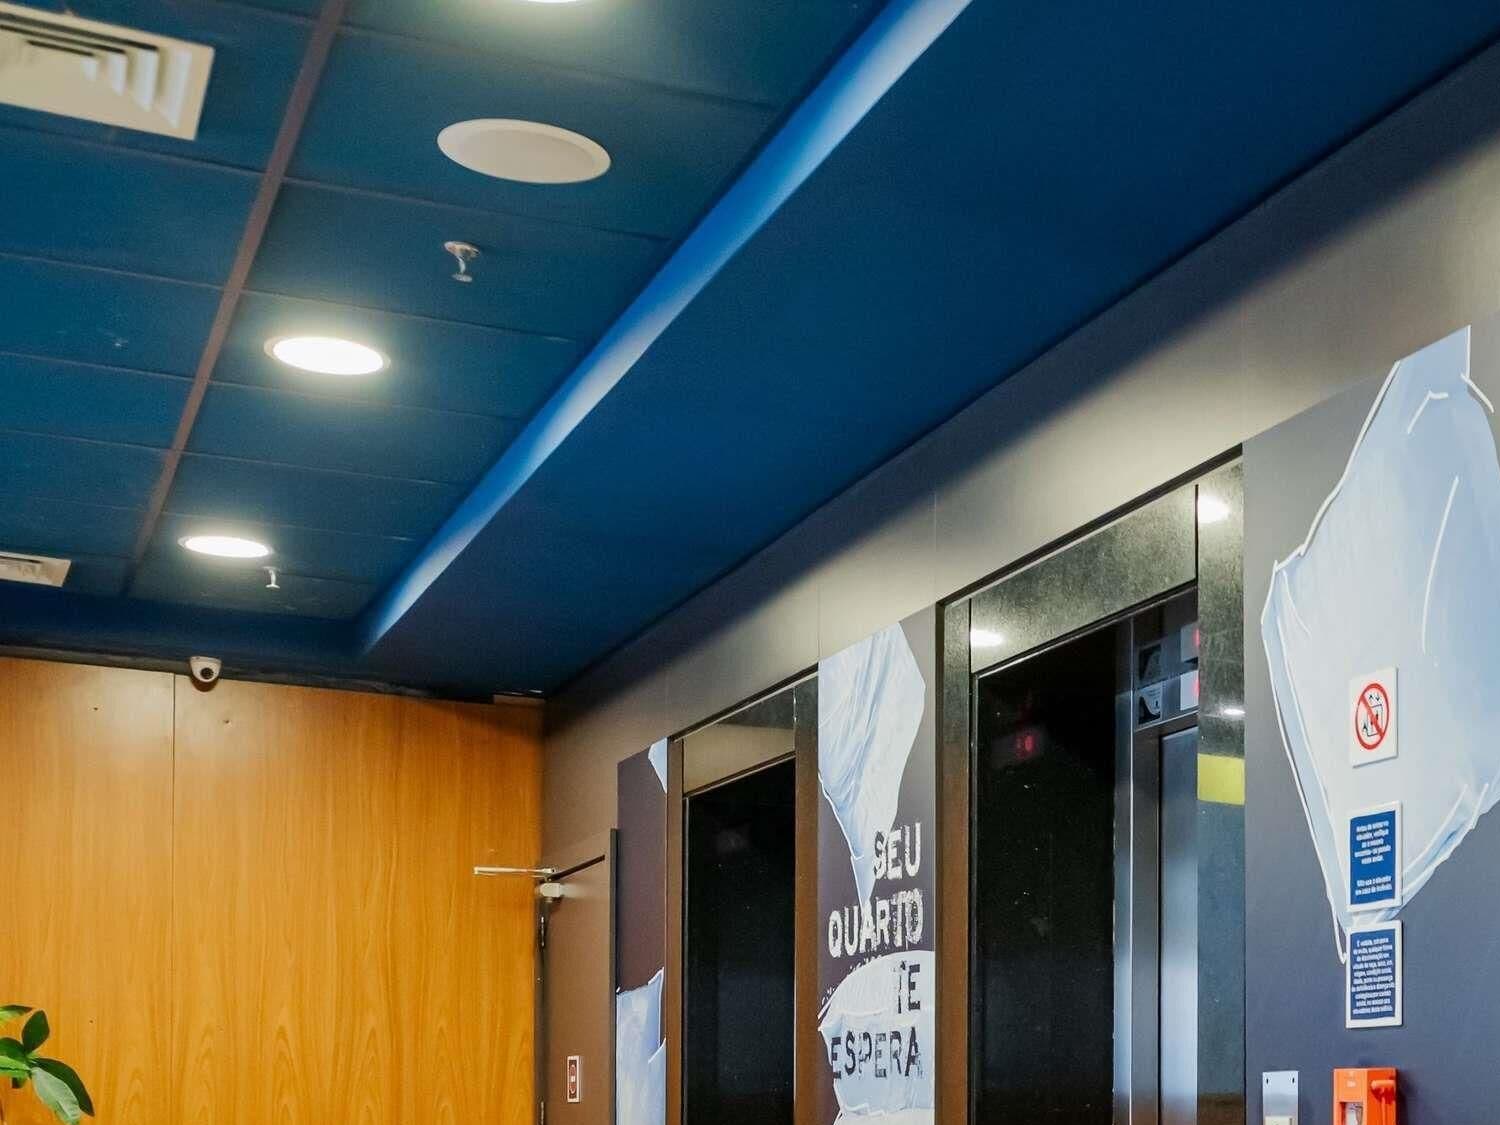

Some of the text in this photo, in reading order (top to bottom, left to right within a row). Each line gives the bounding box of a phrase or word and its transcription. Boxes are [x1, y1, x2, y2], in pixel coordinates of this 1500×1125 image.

[873, 822, 922, 880] SEU
[828, 887, 924, 959] QUARTO
[830, 1027, 924, 1080] ESPERA
